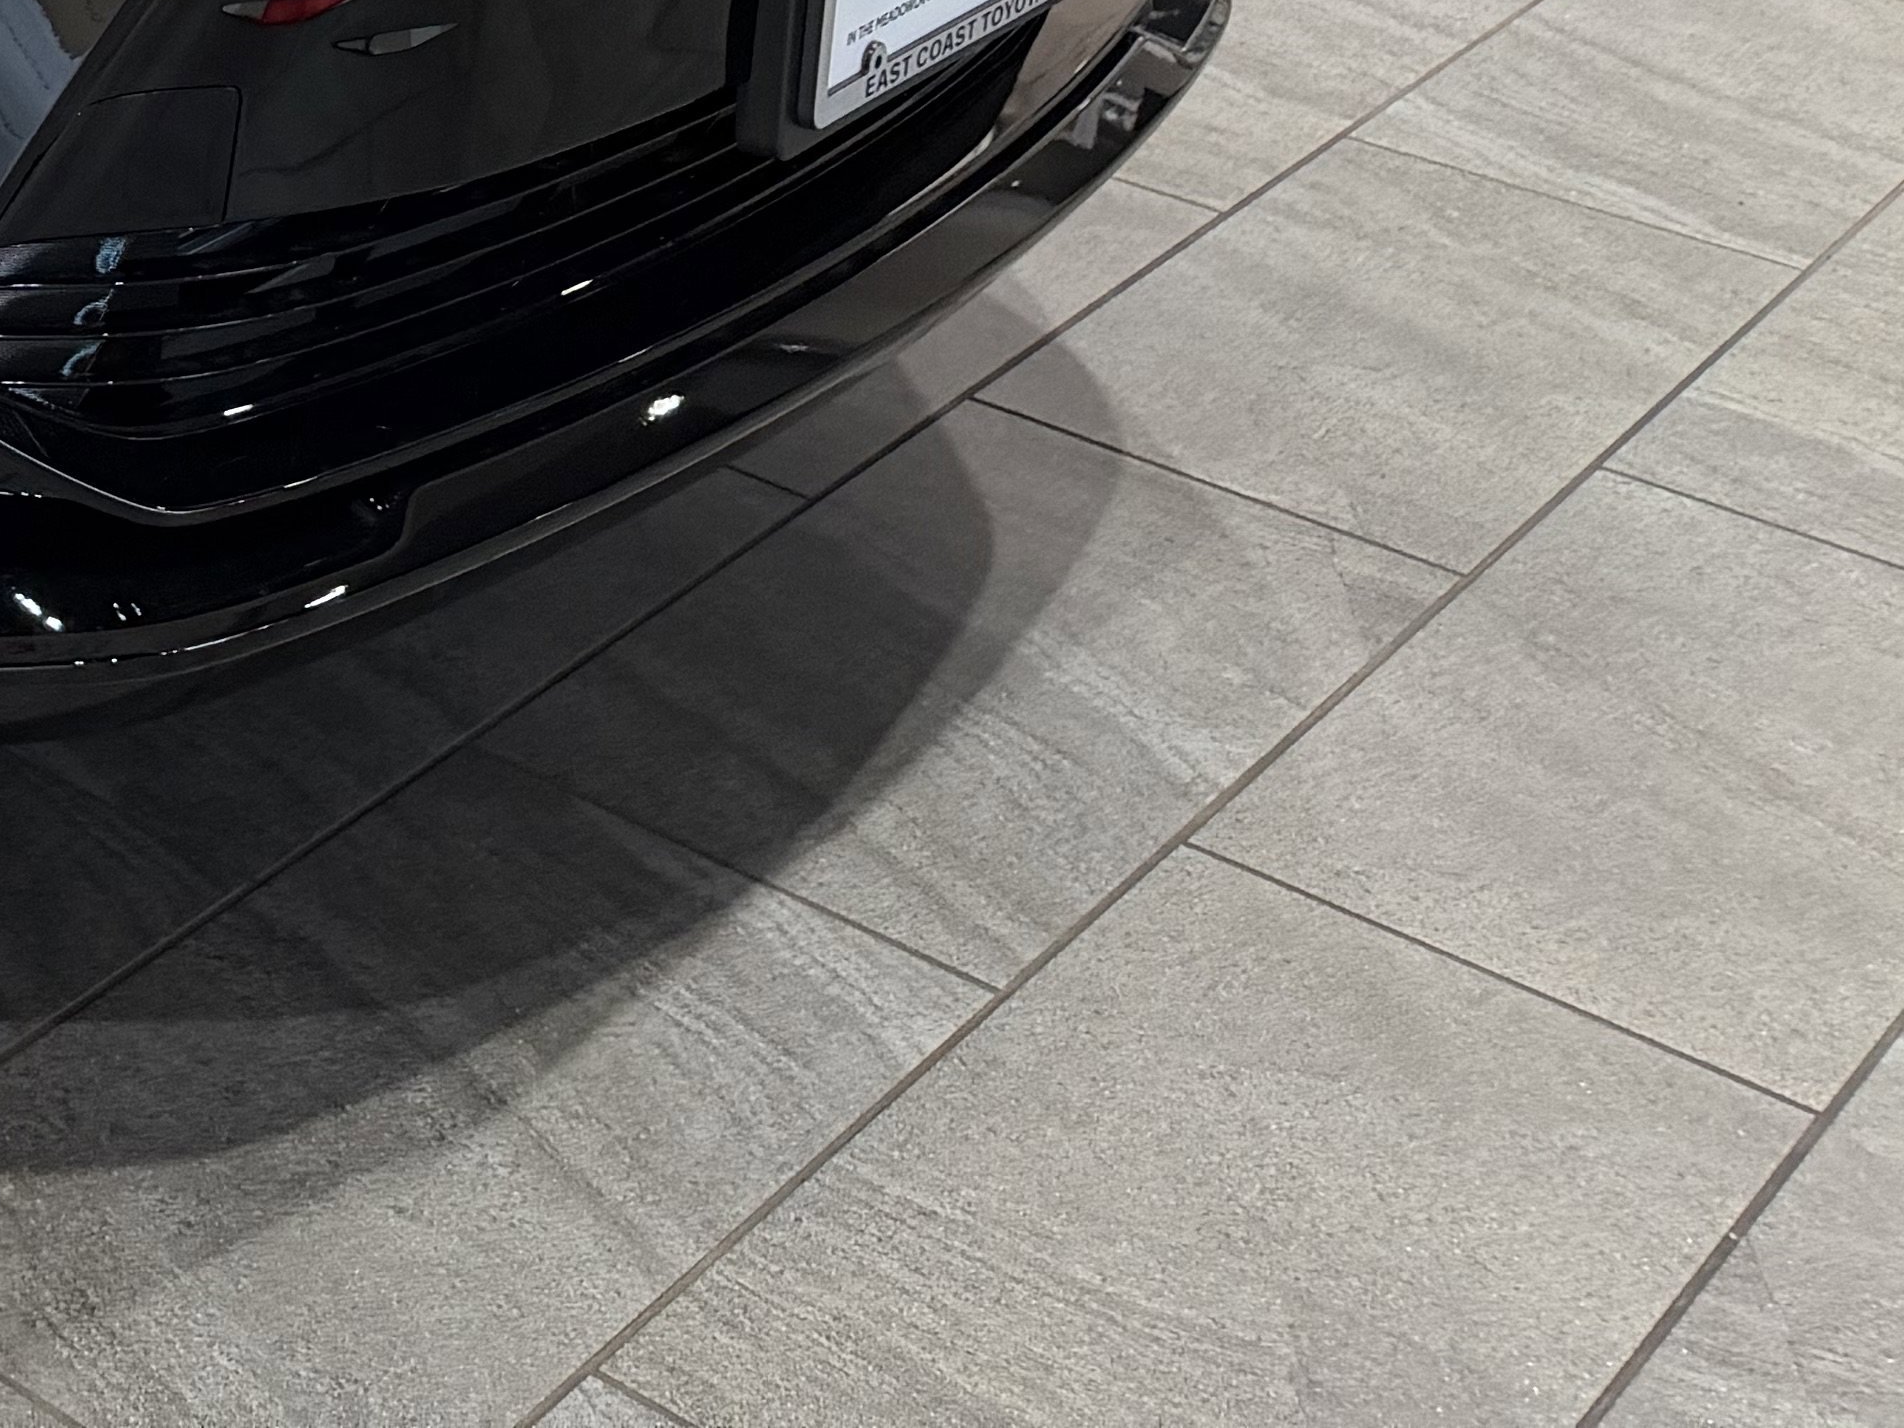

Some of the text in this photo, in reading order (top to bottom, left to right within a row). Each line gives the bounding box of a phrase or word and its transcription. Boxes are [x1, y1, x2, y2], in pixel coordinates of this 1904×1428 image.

[847, 32, 857, 45] IN
[858, 19, 874, 40] THE
[864, 55, 910, 98] EAST
[915, 19, 976, 69] COAST
